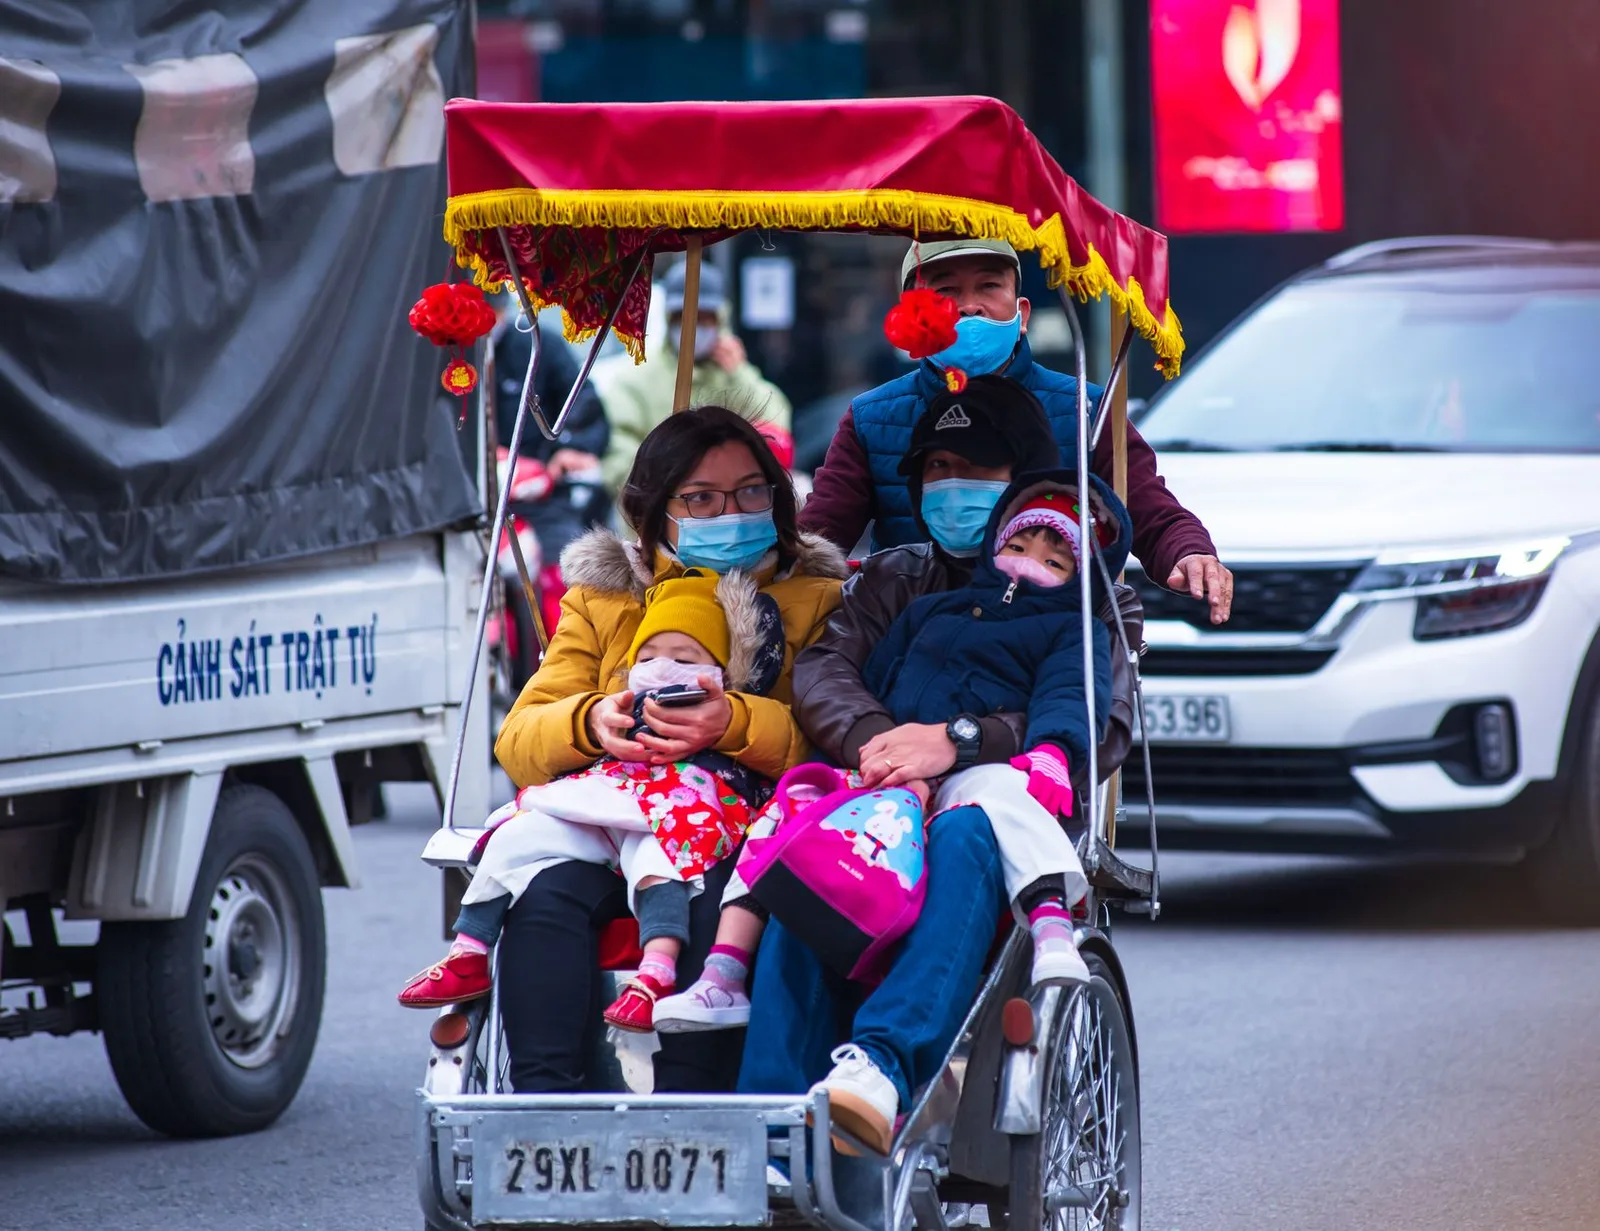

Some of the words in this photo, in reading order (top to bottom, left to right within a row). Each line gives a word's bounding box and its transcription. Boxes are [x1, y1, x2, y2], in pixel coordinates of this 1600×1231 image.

[157, 617, 222, 706] CẢNH
[230, 619, 273, 699] SÁT
[281, 613, 339, 700] TRẬT
[347, 612, 378, 696] TỰ
[506, 1147, 728, 1194] 29XL-0071
